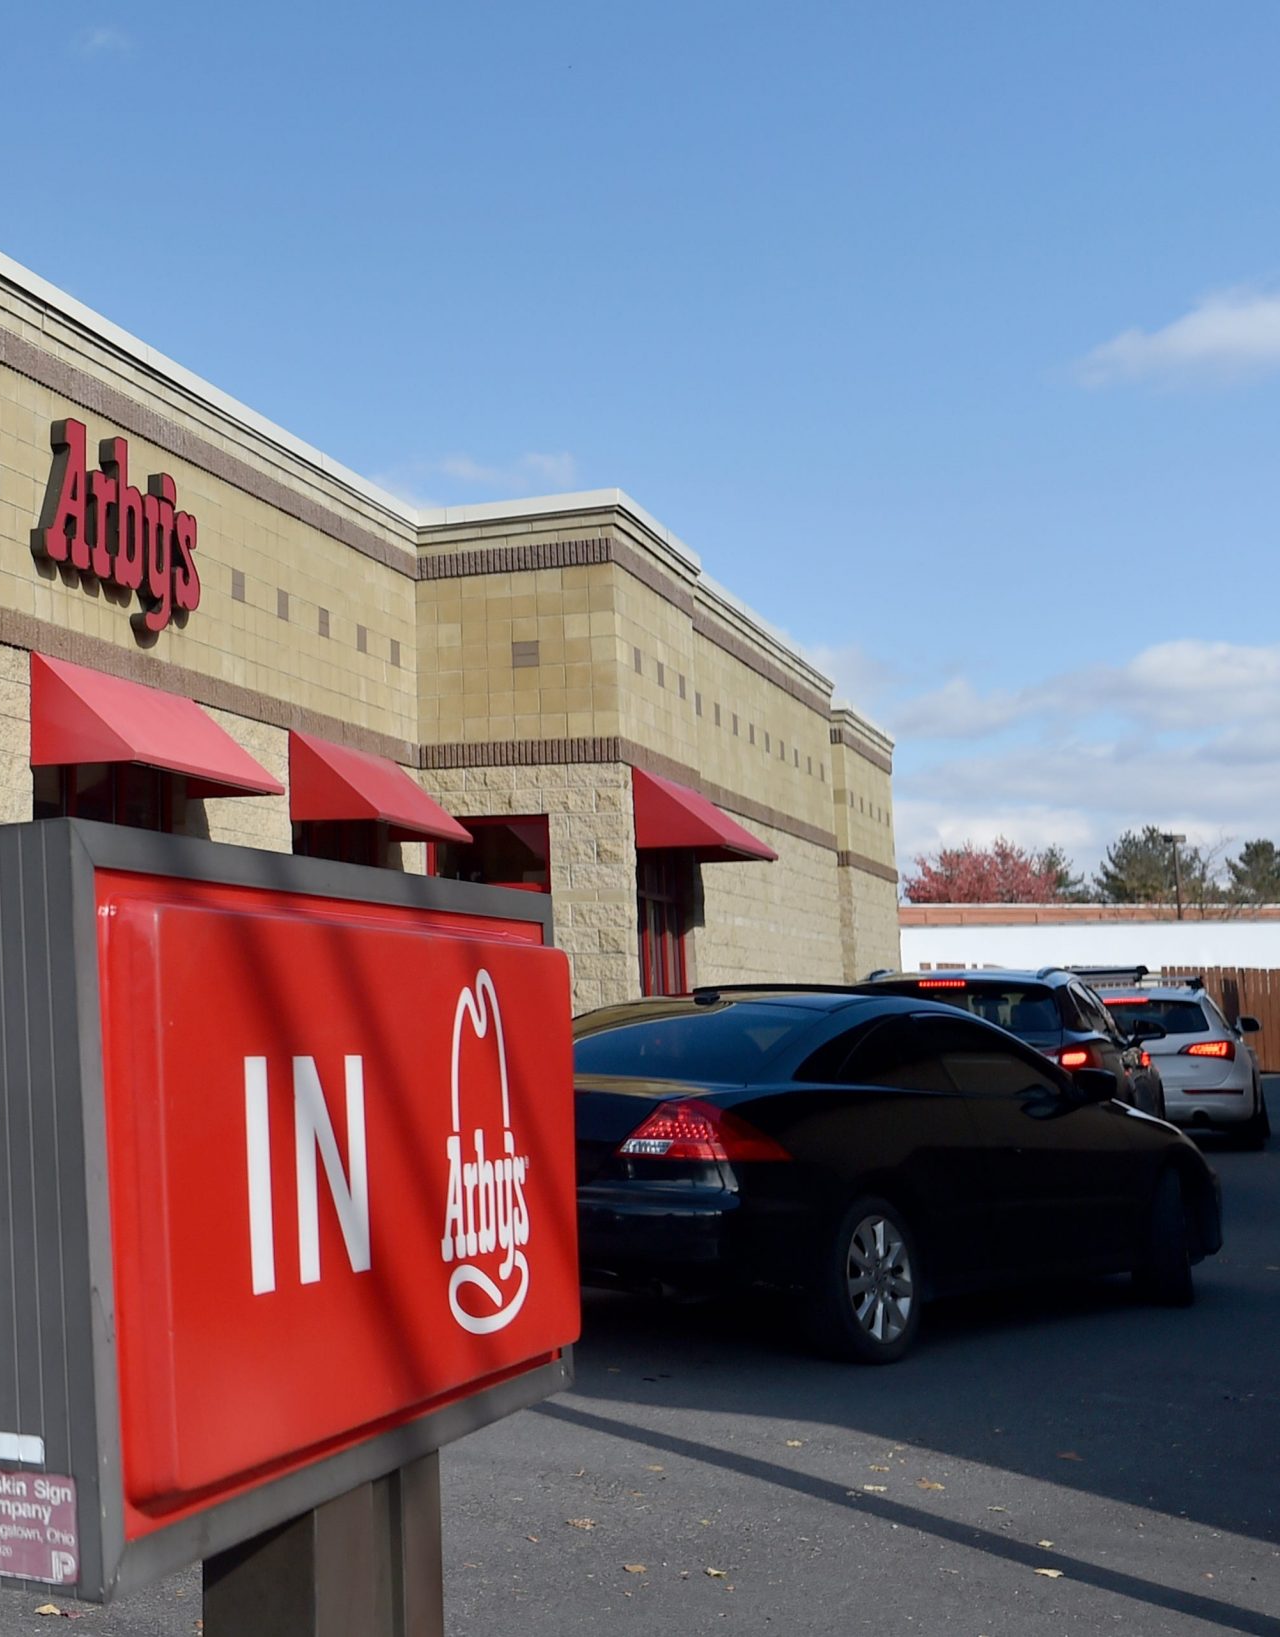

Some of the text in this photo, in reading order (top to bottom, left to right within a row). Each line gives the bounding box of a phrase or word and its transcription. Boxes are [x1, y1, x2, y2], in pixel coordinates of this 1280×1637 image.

[32, 417, 201, 632] Arby's
[244, 1054, 372, 1296] IN
[441, 1128, 530, 1281] Arby's
[33, 1479, 73, 1506] Sign
